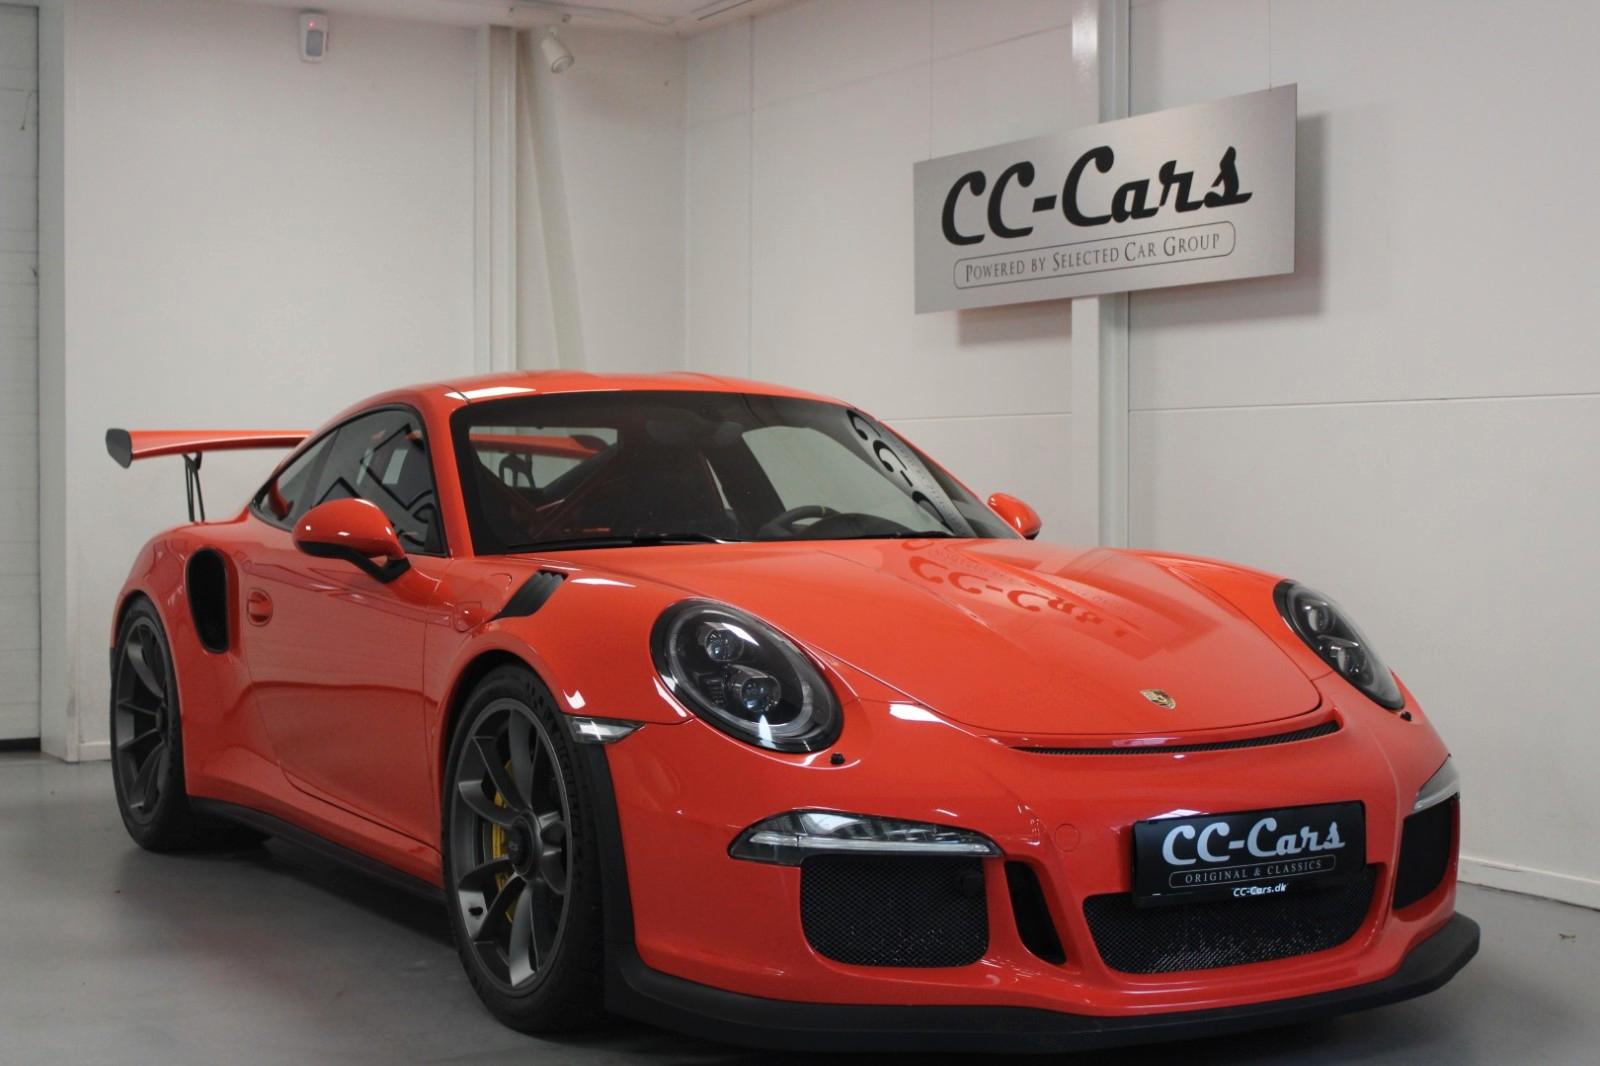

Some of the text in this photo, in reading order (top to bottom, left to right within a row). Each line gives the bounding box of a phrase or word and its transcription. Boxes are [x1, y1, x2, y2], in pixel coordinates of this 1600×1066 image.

[942, 145, 1253, 246] CC-Cars
[965, 260, 1025, 283] POWERED
[1052, 247, 1119, 272] SELECTED
[1124, 241, 1157, 262] CAR
[1163, 233, 1220, 257] GROUP
[1162, 817, 1346, 866] CC-Cars
[1184, 871, 1248, 884] ORIGINAL
[1266, 859, 1322, 875] CLASSICS
[1233, 883, 1288, 897] CC-Cars.dk
